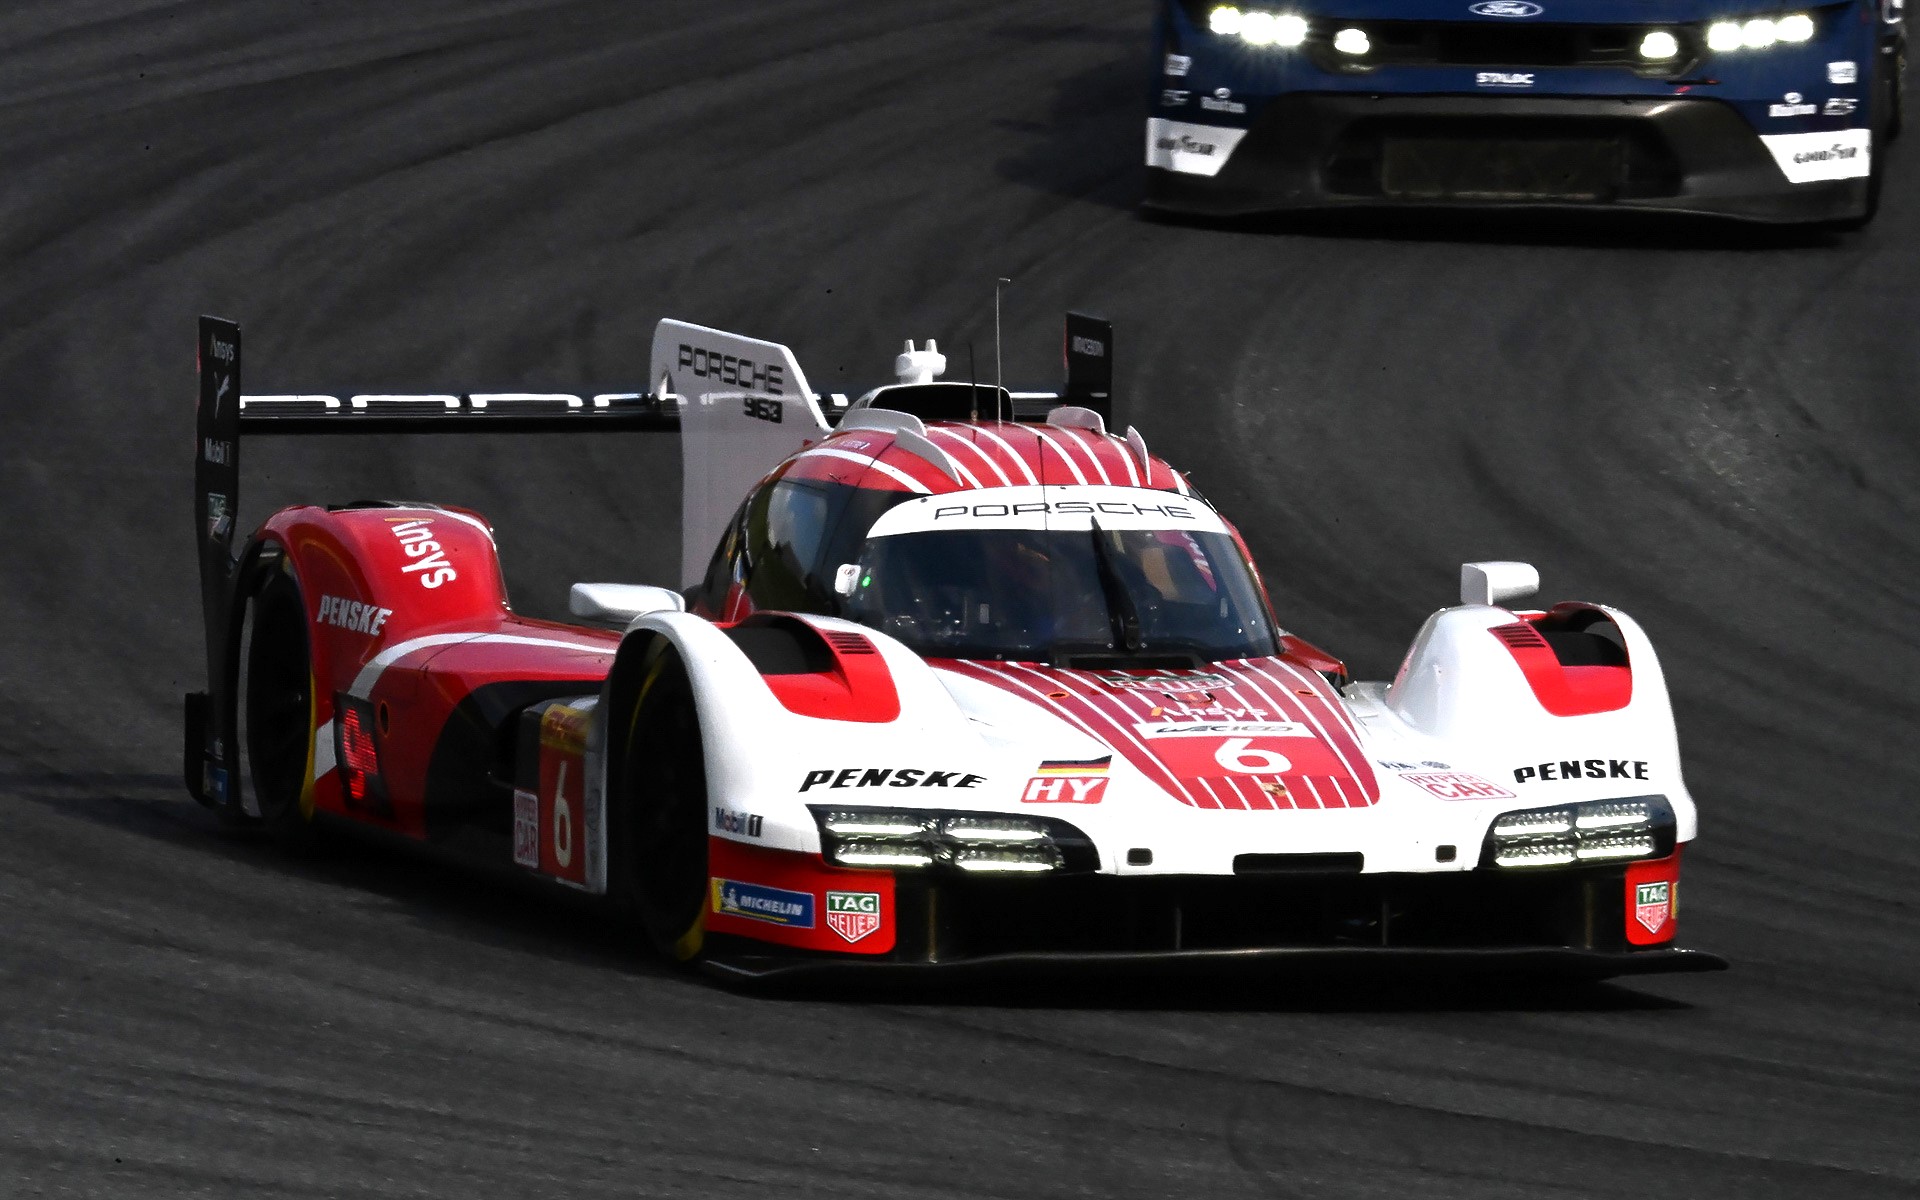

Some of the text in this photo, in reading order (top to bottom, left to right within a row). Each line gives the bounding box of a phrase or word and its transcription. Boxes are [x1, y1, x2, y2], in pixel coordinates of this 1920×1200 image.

[679, 344, 783, 396] PORSCHE
[743, 397, 783, 424] 963
[934, 501, 1196, 520] PORSCHE
[384, 517, 457, 589] Ansys
[316, 595, 393, 637] PENSKE
[1214, 738, 1293, 774] 6
[798, 768, 988, 793] PENSKE
[1513, 759, 1650, 784] PENSKE
[1025, 778, 1099, 801] HY
[1427, 782, 1506, 798] CAR
[554, 760, 572, 868] 6
[715, 807, 747, 835] Mobil
[740, 895, 804, 916] MICHELIN
[830, 896, 874, 912] TAG
[1640, 886, 1667, 903] TAG
[829, 914, 876, 938] HEUER
